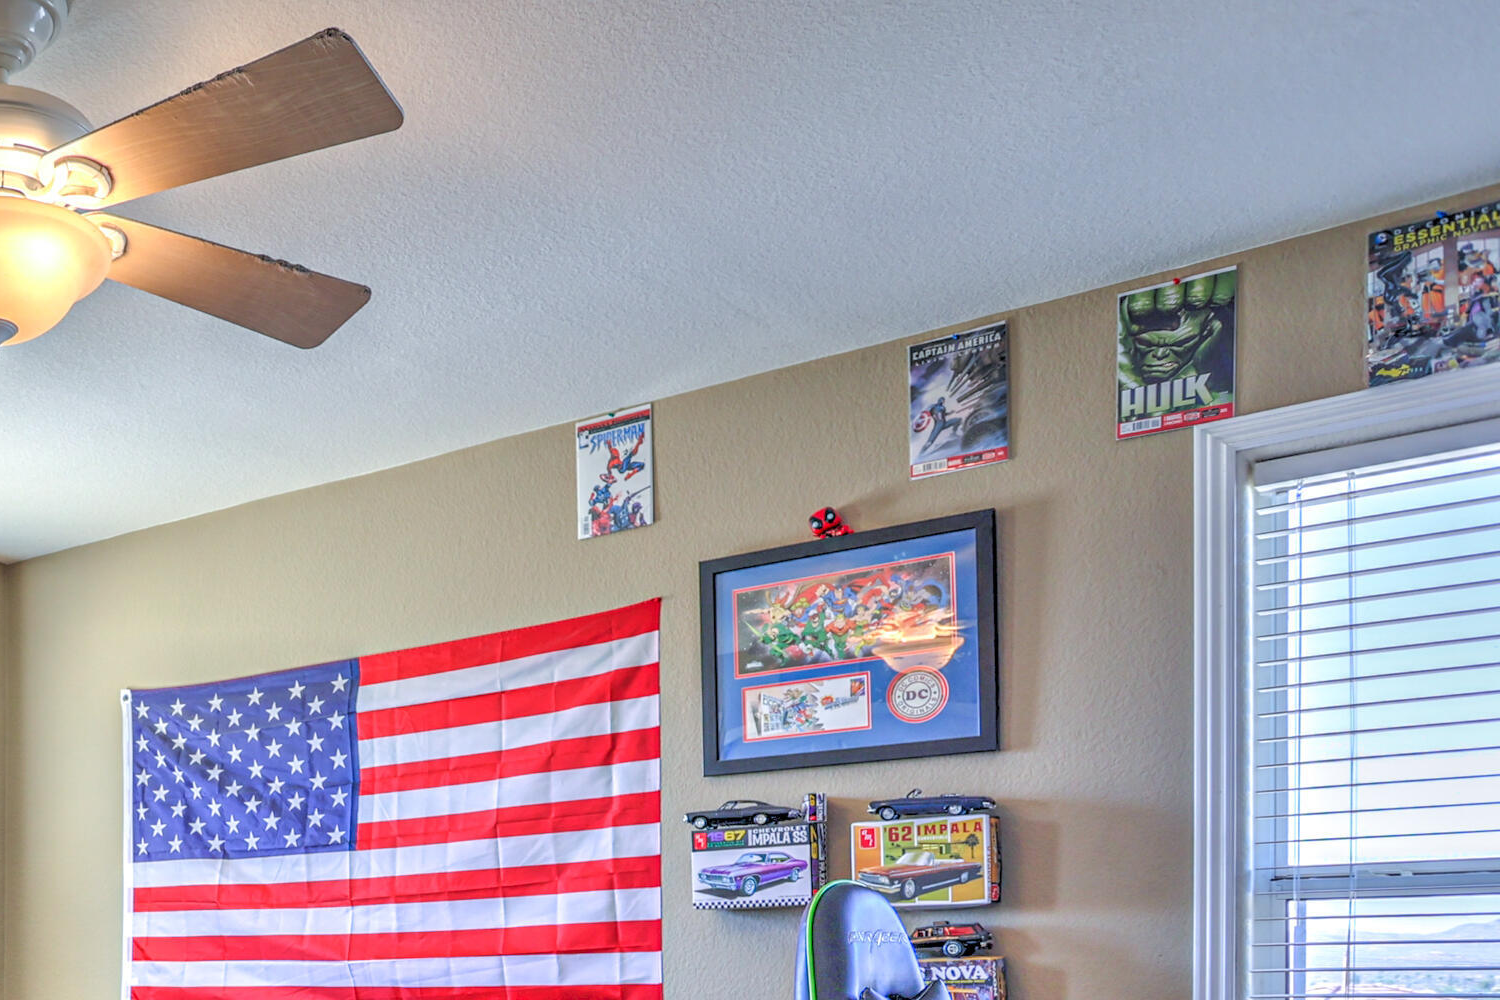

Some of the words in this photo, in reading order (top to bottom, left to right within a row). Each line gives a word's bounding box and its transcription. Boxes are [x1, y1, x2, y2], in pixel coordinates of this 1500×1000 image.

[1393, 210, 1500, 246] ESSENTIAL
[1394, 234, 1448, 252] GRAPHIC
[912, 343, 955, 361] CAPTAIN
[957, 332, 1002, 350] AMERICA
[1121, 372, 1214, 418] HULK
[905, 688, 929, 701] DC
[707, 829, 746, 843] 1967
[753, 825, 807, 835] CHEVROLET
[917, 821, 983, 836] IMPALA
[748, 829, 792, 847] IMPALA
[793, 831, 808, 844] SS
[931, 964, 989, 981] NOVA
